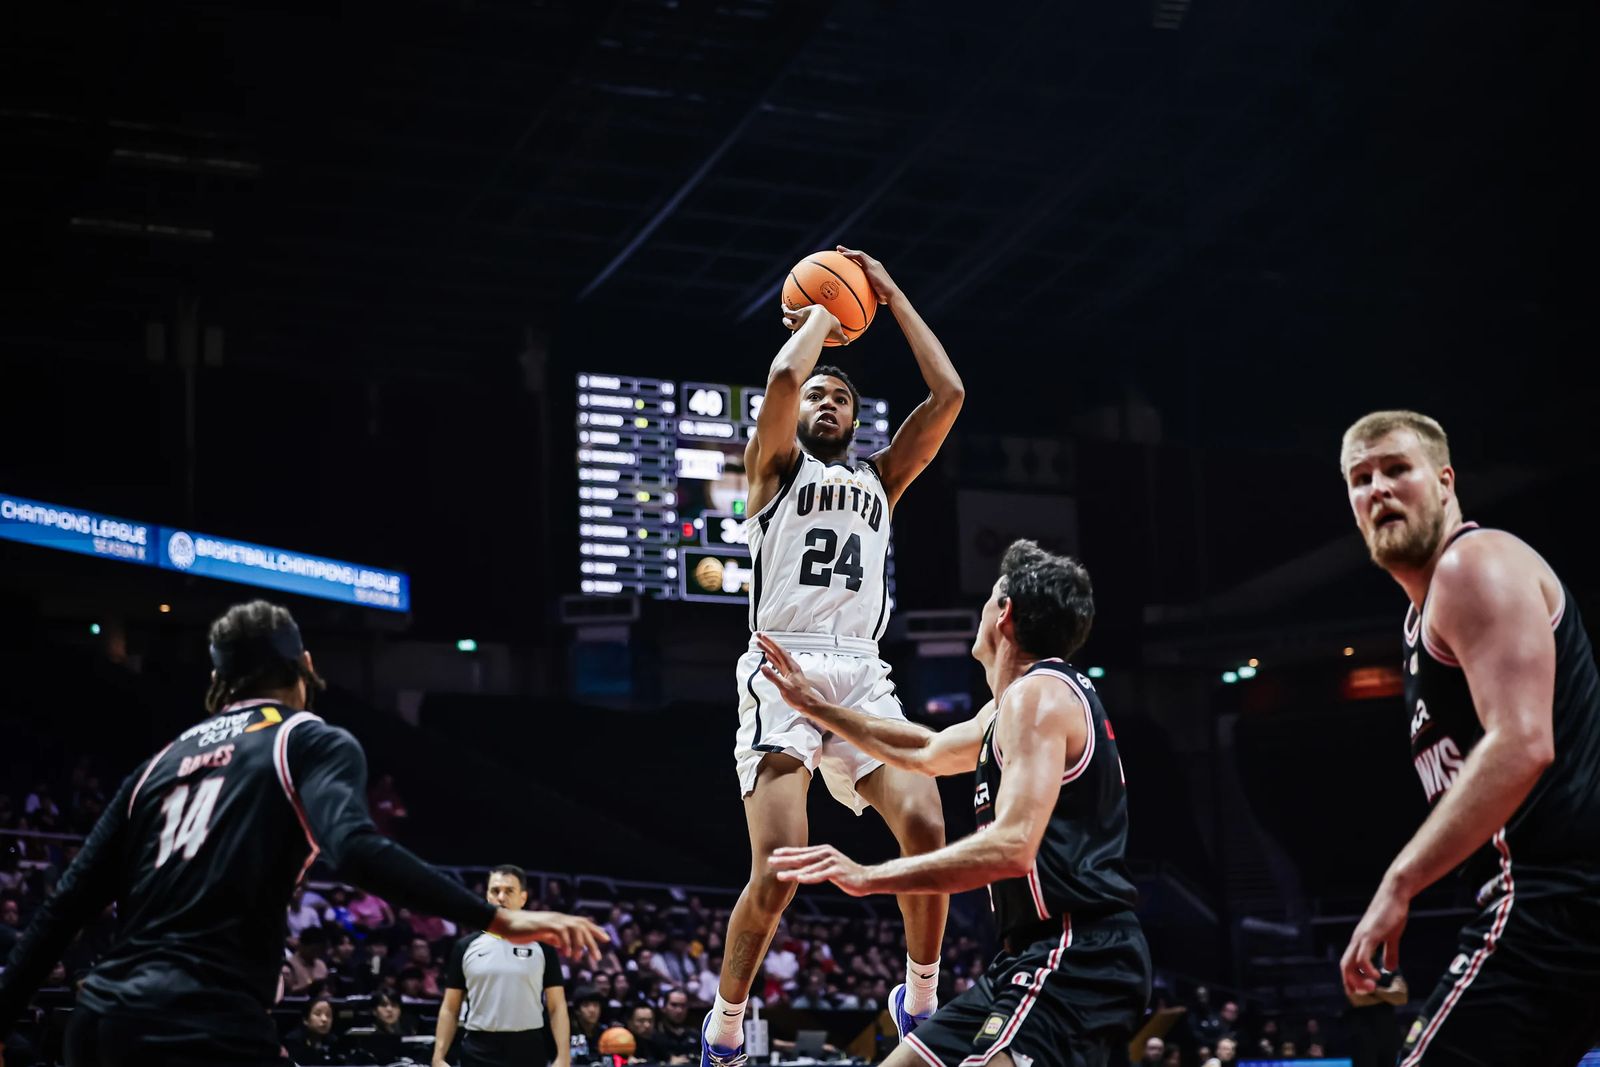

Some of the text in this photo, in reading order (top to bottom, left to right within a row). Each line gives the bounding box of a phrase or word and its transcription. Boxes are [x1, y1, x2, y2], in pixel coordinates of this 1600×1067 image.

[688, 389, 723, 417] 40
[1, 500, 147, 545] CHAMPIONS LEAGUE
[797, 482, 883, 533] UNITED
[196, 538, 277, 570] BASKETBALL
[799, 528, 863, 592] 24
[155, 777, 225, 868] 14
